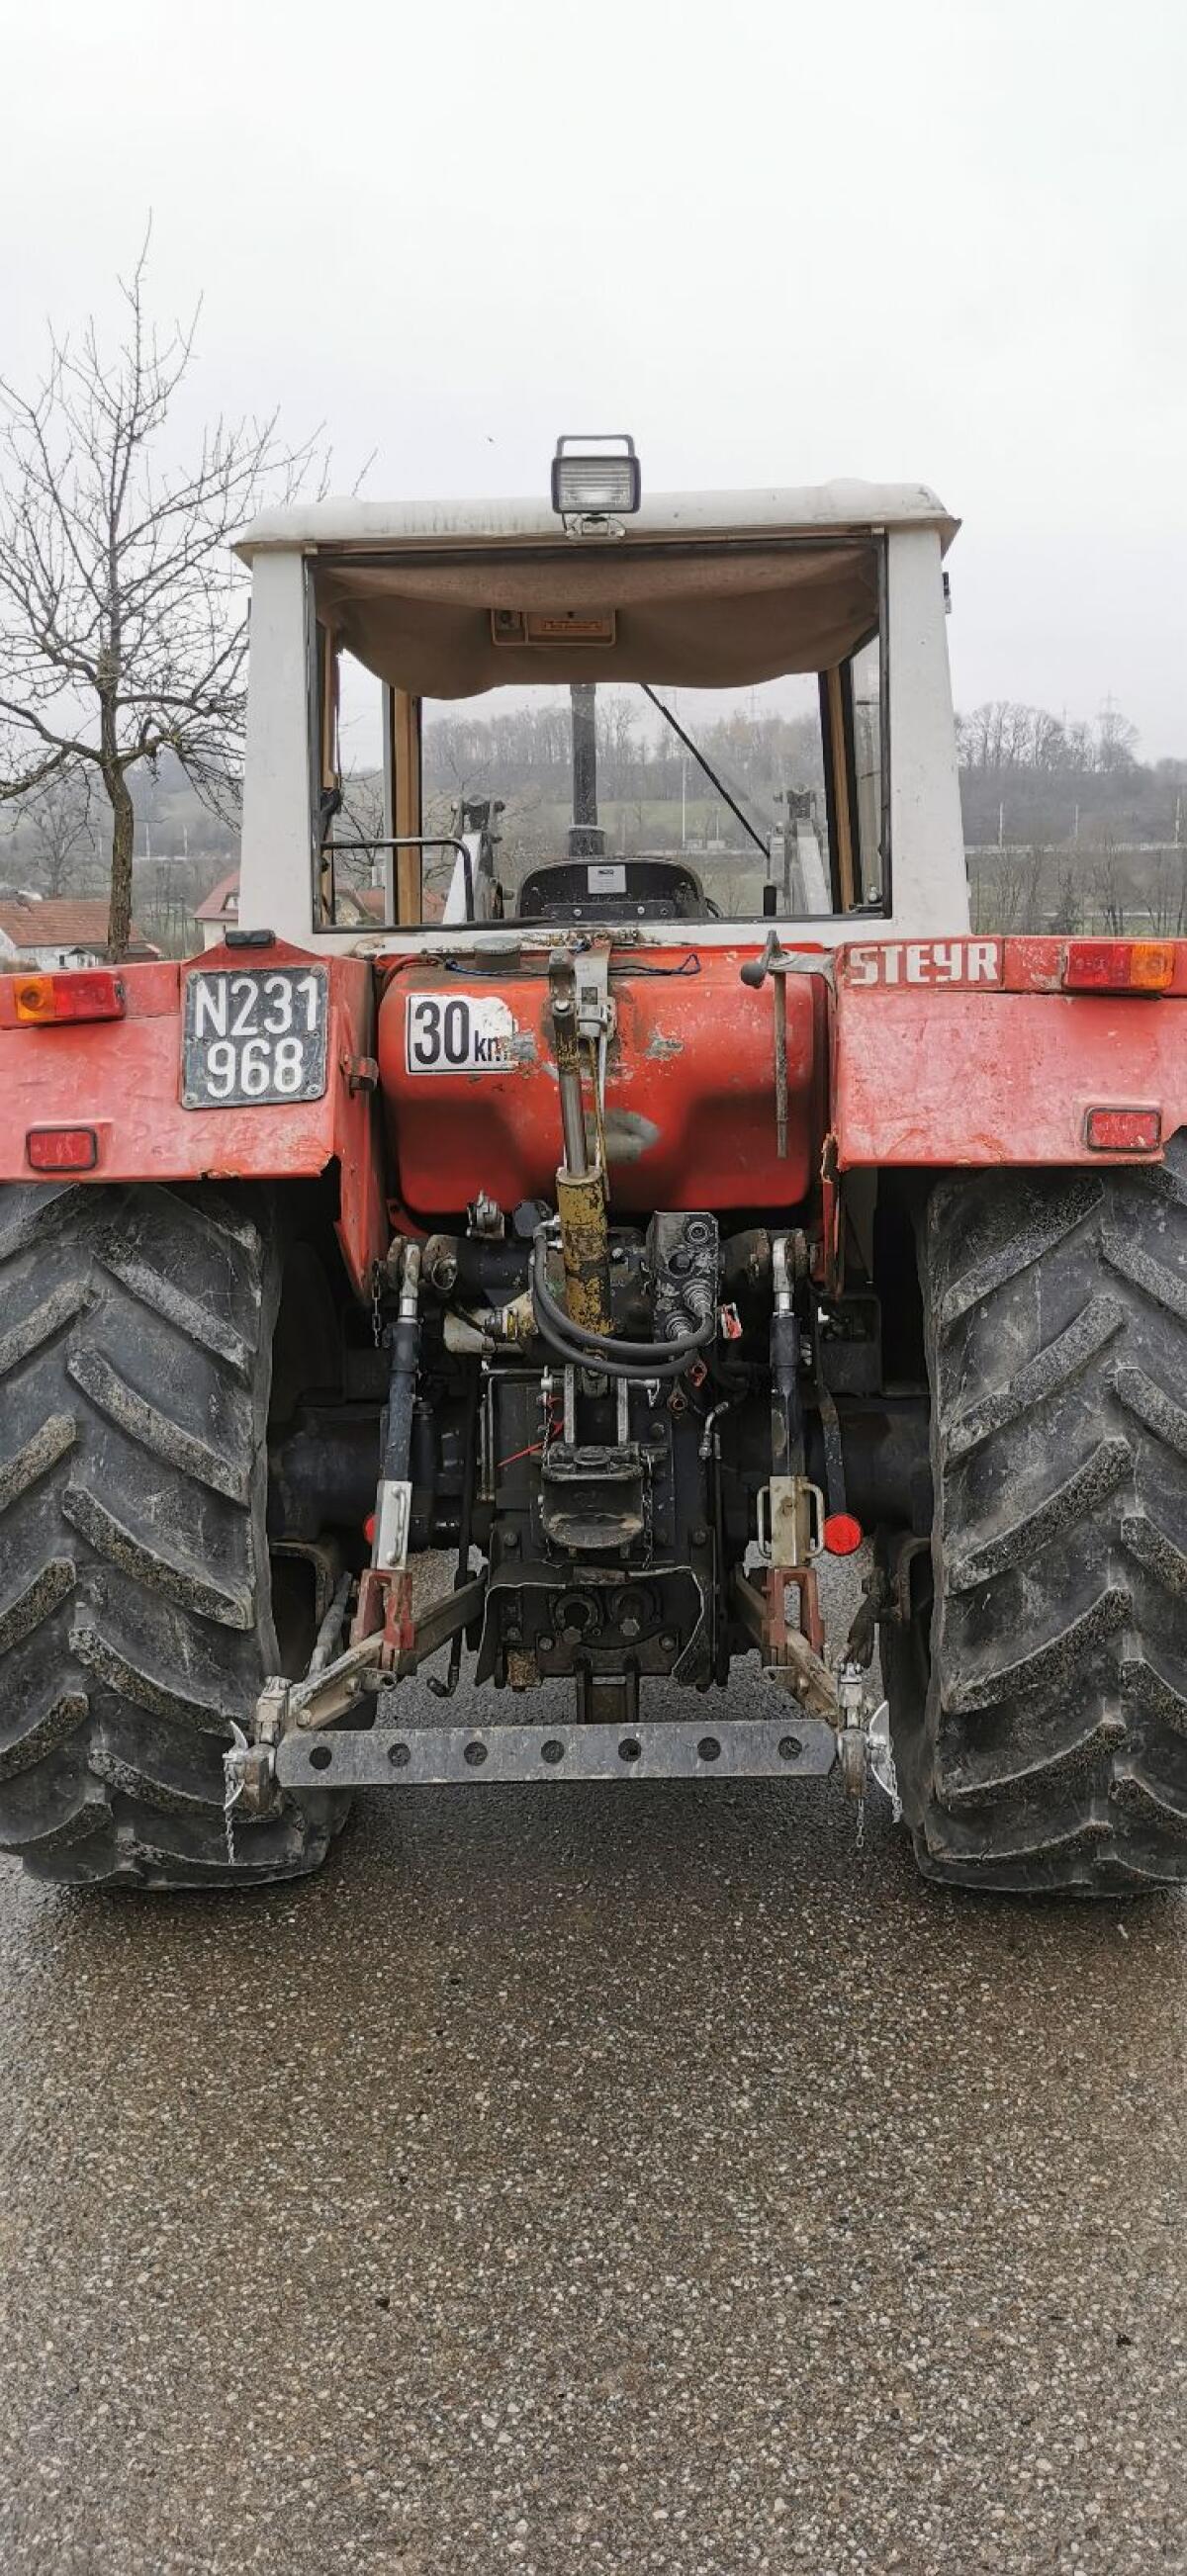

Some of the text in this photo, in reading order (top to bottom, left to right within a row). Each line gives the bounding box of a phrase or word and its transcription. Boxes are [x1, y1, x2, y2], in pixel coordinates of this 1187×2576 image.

[850, 942, 998, 985] STEYR
[196, 976, 318, 1037] N231
[413, 1001, 470, 1064] 30
[207, 1037, 304, 1098] 968
